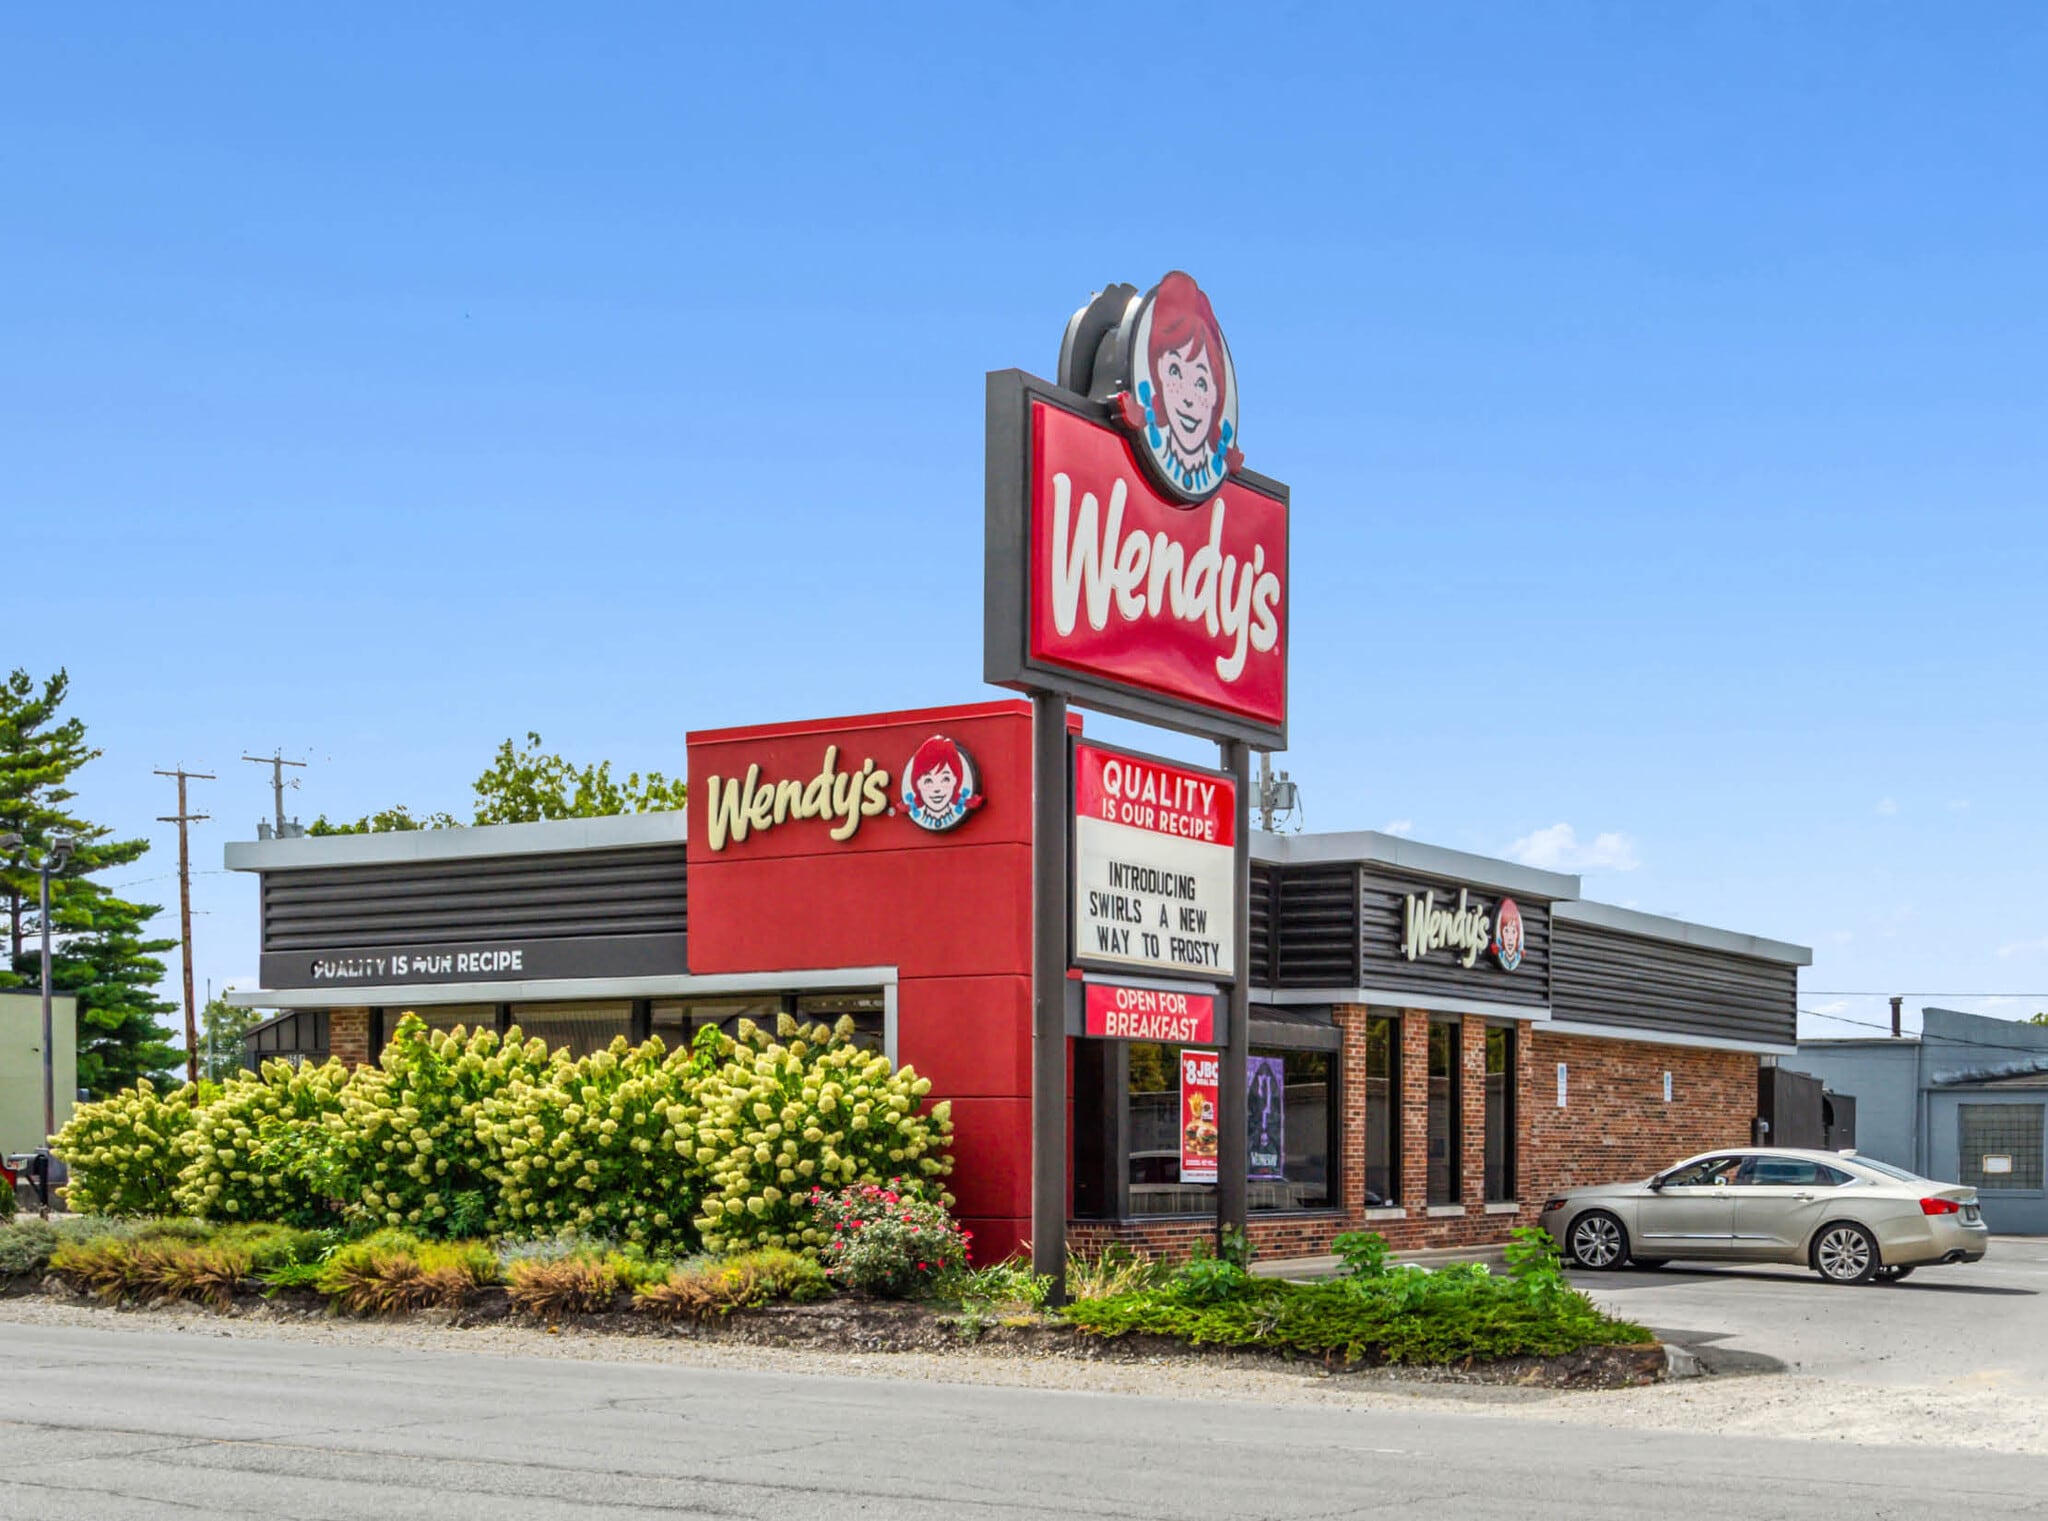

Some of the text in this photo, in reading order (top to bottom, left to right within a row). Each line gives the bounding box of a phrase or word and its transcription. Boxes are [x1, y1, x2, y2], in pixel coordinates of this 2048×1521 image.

[1052, 472, 1280, 682] Wendy's
[707, 745, 889, 851] Wendy's
[1103, 760, 1216, 816] QUALITY
[1102, 798, 1214, 841] IS OUR RECIPE
[1109, 861, 1195, 901] INTRODUCING
[1090, 891, 1207, 934] SWIRLS A NEW
[1407, 888, 1489, 968] Wendy's
[392, 956, 408, 975] IS
[457, 951, 523, 972] RECIPE
[1097, 925, 1219, 967] WAY TO FROSTY
[1116, 988, 1187, 1015] OPEN FOR
[1106, 1012, 1198, 1042] BREAKFAST
